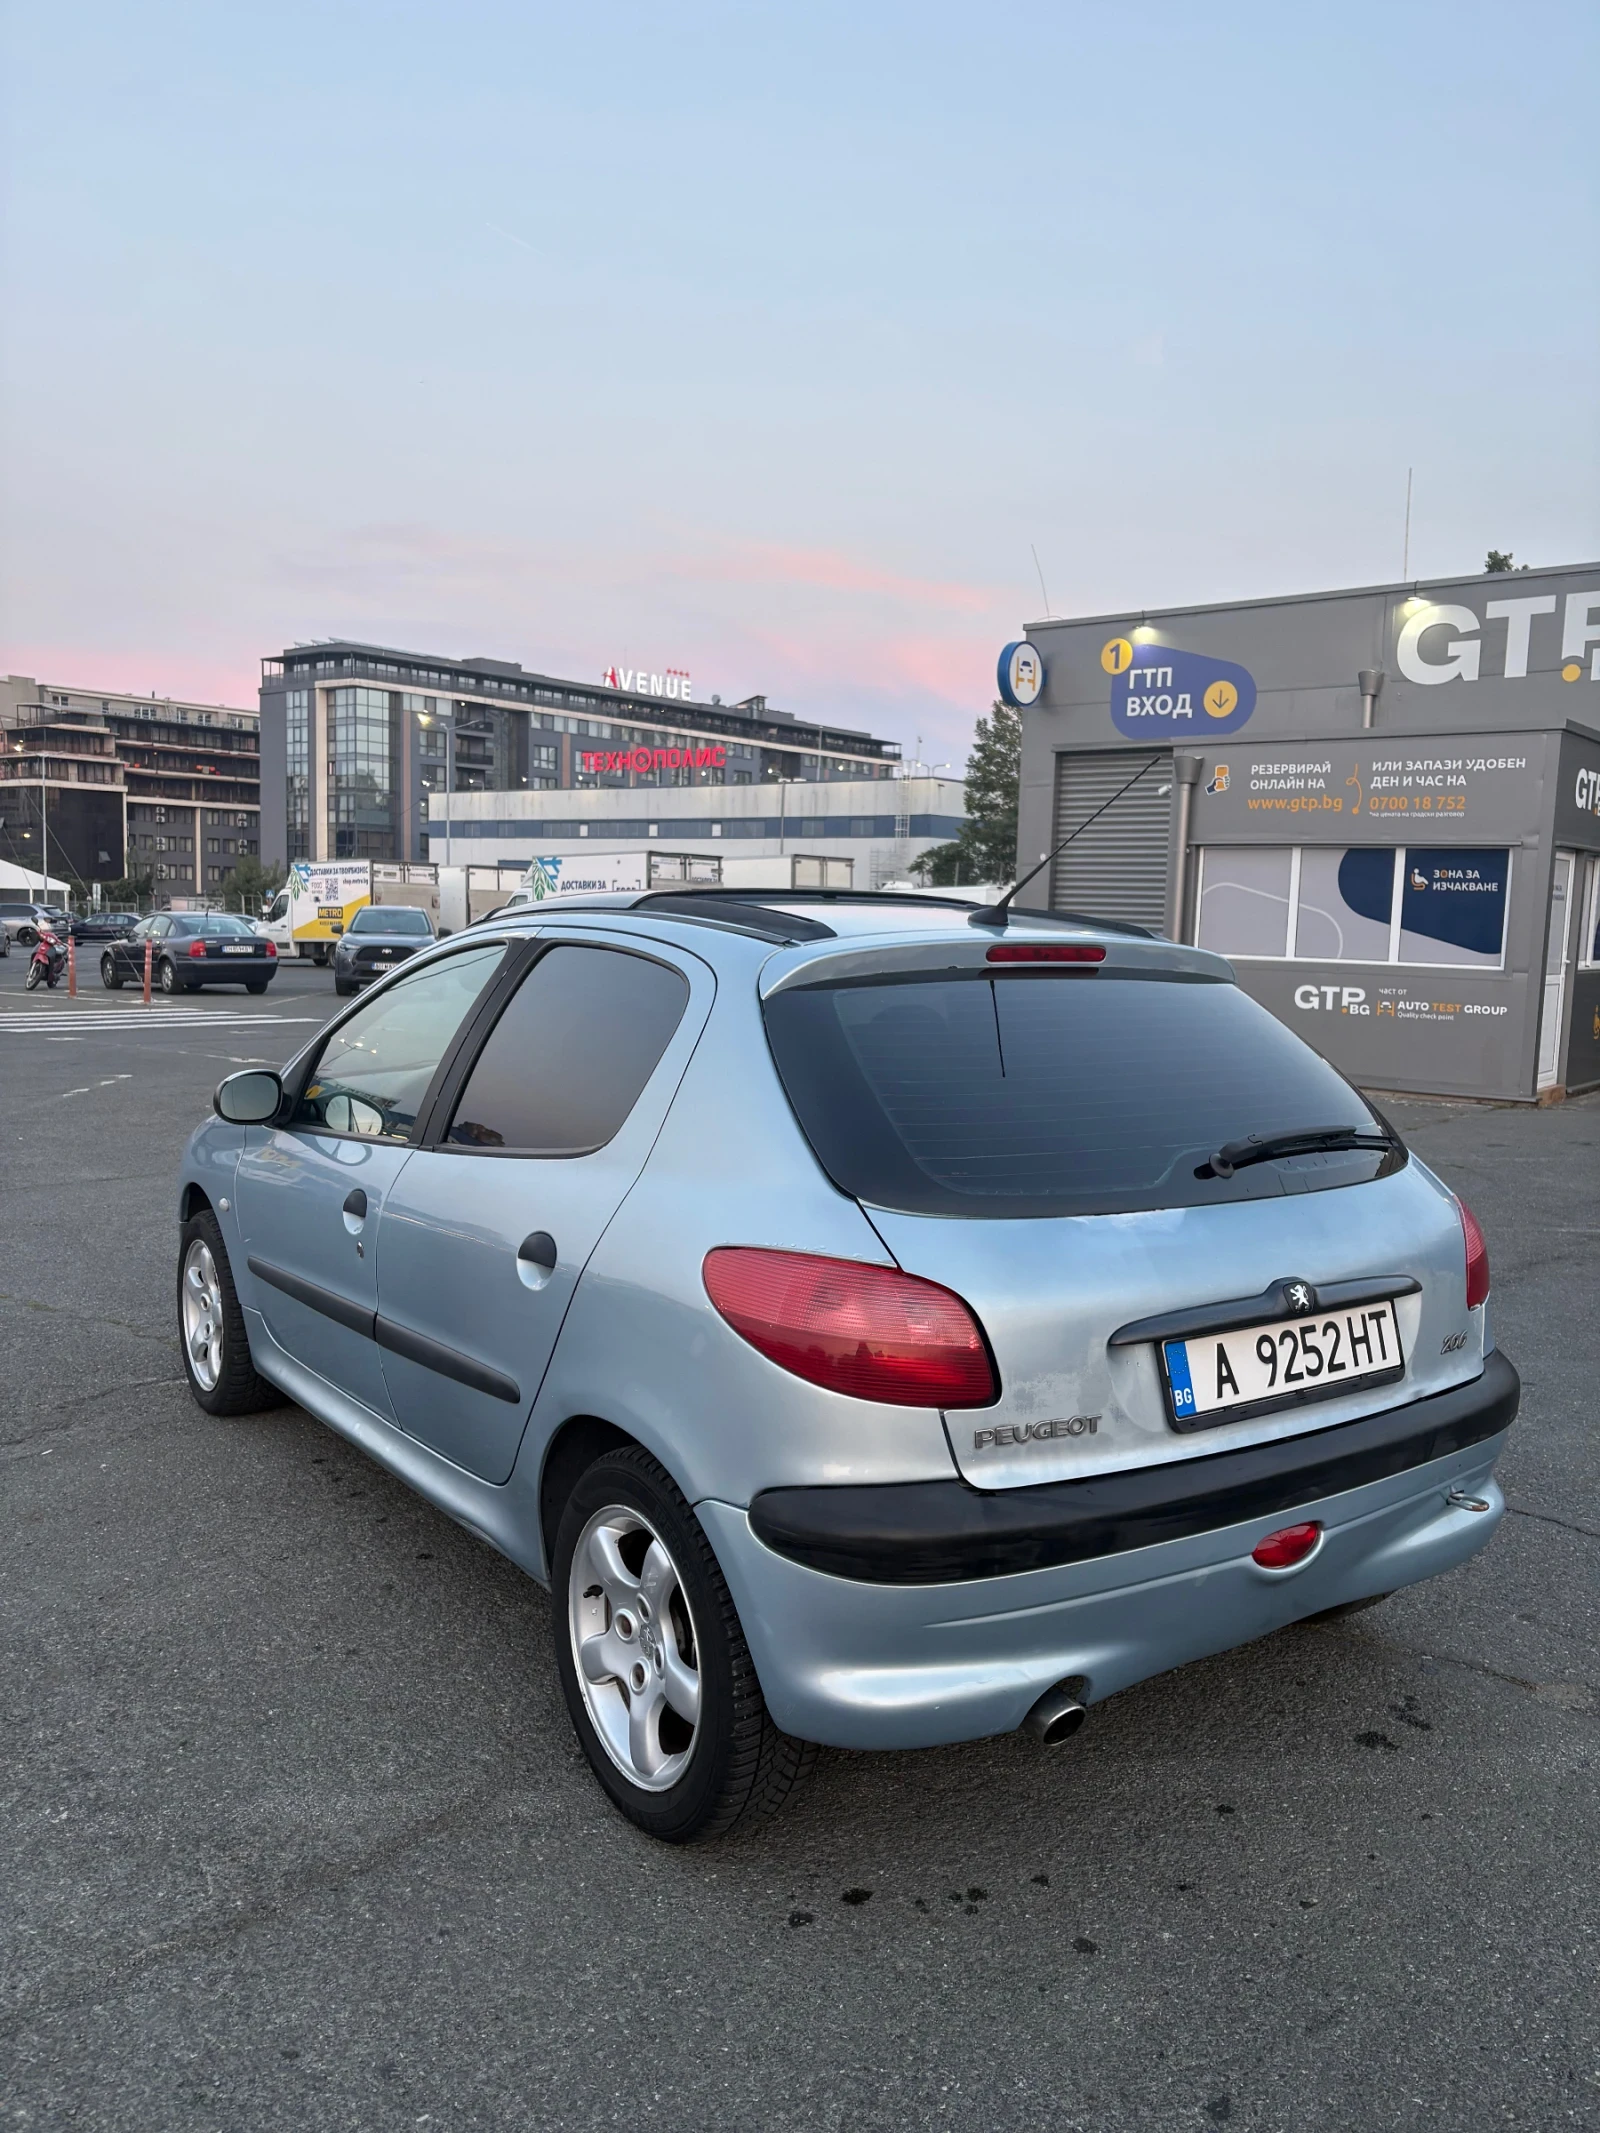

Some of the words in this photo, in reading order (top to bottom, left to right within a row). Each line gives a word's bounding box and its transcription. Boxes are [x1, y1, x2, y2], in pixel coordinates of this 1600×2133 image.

[1109, 643, 1121, 669] 1
[603, 666, 692, 700] AVENUE
[1129, 667, 1173, 690] ГТП
[1126, 694, 1193, 719] ВХОД
[581, 746, 726, 773] ТЕХНОПОЛИС
[1372, 761, 1402, 771] ИЛИ
[1405, 759, 1462, 771] ЗАПАЗИ
[1466, 758, 1527, 771] УДОБЕН
[1251, 761, 1332, 775] РЕЗЕРВИРАЙ
[1250, 776, 1304, 790] ОНЛАЙН
[1307, 778, 1326, 789] НА
[1370, 776, 1399, 789] ДЕН
[1403, 776, 1413, 787] И
[1416, 775, 1443, 787] ЧАС
[1447, 775, 1467, 786] НА
[1247, 794, 1343, 812] www.gtp.bg
[1369, 796, 1408, 810] 0700
[1413, 796, 1432, 810] 18
[1436, 795, 1466, 810] 752
[1433, 869, 1463, 879] ЗОНА
[1466, 869, 1480, 879] ЗА
[560, 880, 597, 891] ДОСТАВКИ
[597, 880, 607, 889] ЗА
[1432, 882, 1498, 892] ИЗЧАКВАНЕ
[319, 908, 343, 918] METRO
[1294, 985, 1366, 1010] GTP
[1379, 987, 1396, 995] част
[1397, 1011, 1419, 1020] Quality
[1398, 1001, 1430, 1011] AUTO
[1432, 1003, 1462, 1013] TEST
[1464, 1005, 1508, 1015] GROUP
[1440, 1329, 1468, 1355] 206
[1216, 1342, 1240, 1399] A
[1256, 1321, 1347, 1388] 9252
[1347, 1309, 1388, 1367] HT
[1174, 1387, 1193, 1407] BG
[974, 1413, 1102, 1449] PEUGEOT
